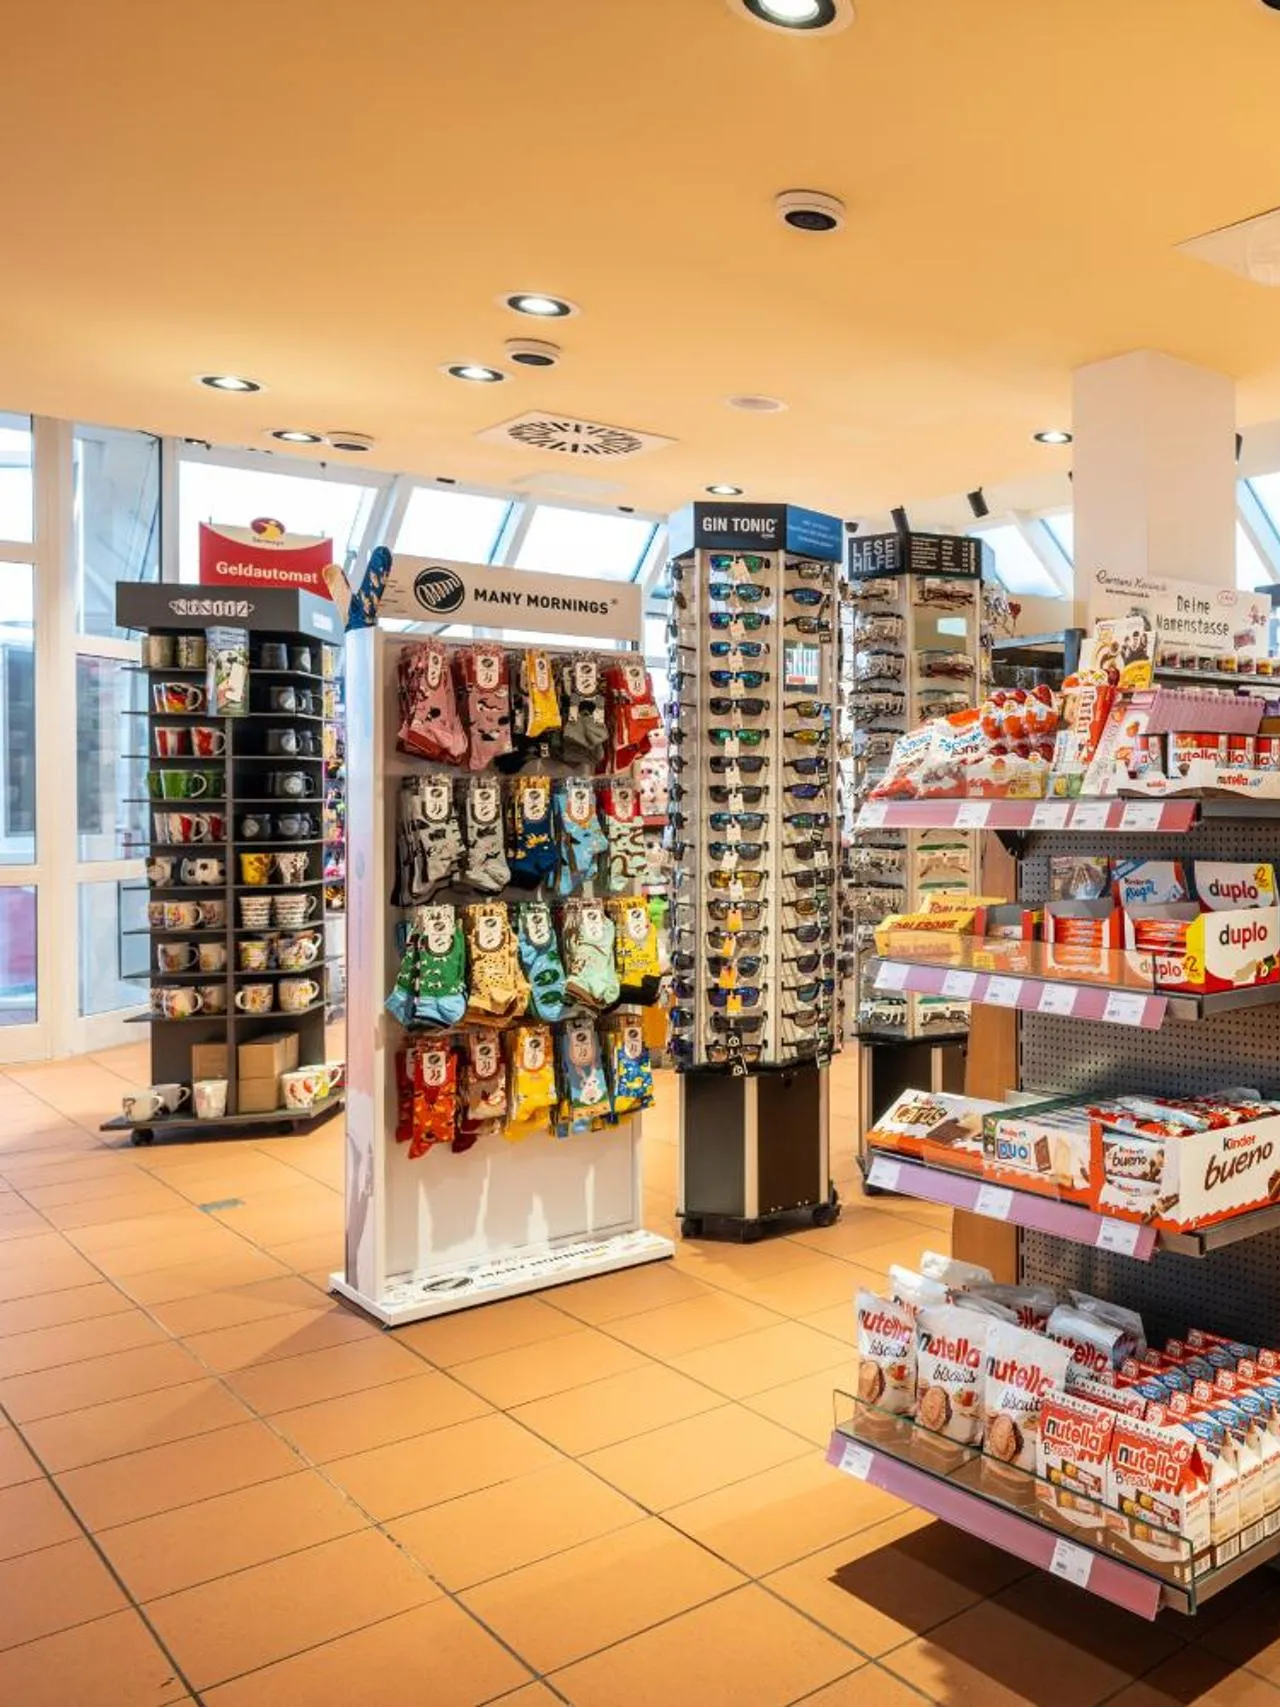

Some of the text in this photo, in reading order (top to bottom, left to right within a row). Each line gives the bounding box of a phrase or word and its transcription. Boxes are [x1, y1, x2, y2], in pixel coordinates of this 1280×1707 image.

[702, 517, 776, 533] GIN TONIC
[853, 539, 894, 557] LESE
[215, 560, 319, 584] Geldautomat
[853, 555, 894, 573] HILFE
[474, 588, 609, 615] MANY MORNINGS
[1177, 594, 1210, 615] Deine
[1156, 614, 1230, 636] Namenstasse
[1209, 879, 1259, 903] duplo
[1219, 922, 1268, 950] duplo
[1112, 1151, 1147, 1167] bueno
[1204, 1141, 1273, 1191] bueno
[858, 1309, 913, 1344] nutella
[918, 1332, 981, 1369] nutella
[986, 1355, 1055, 1398] nutella
[1001, 1389, 1041, 1412] biscuit
[1046, 1416, 1100, 1452] nutella
[1119, 1444, 1179, 1482] nutella
